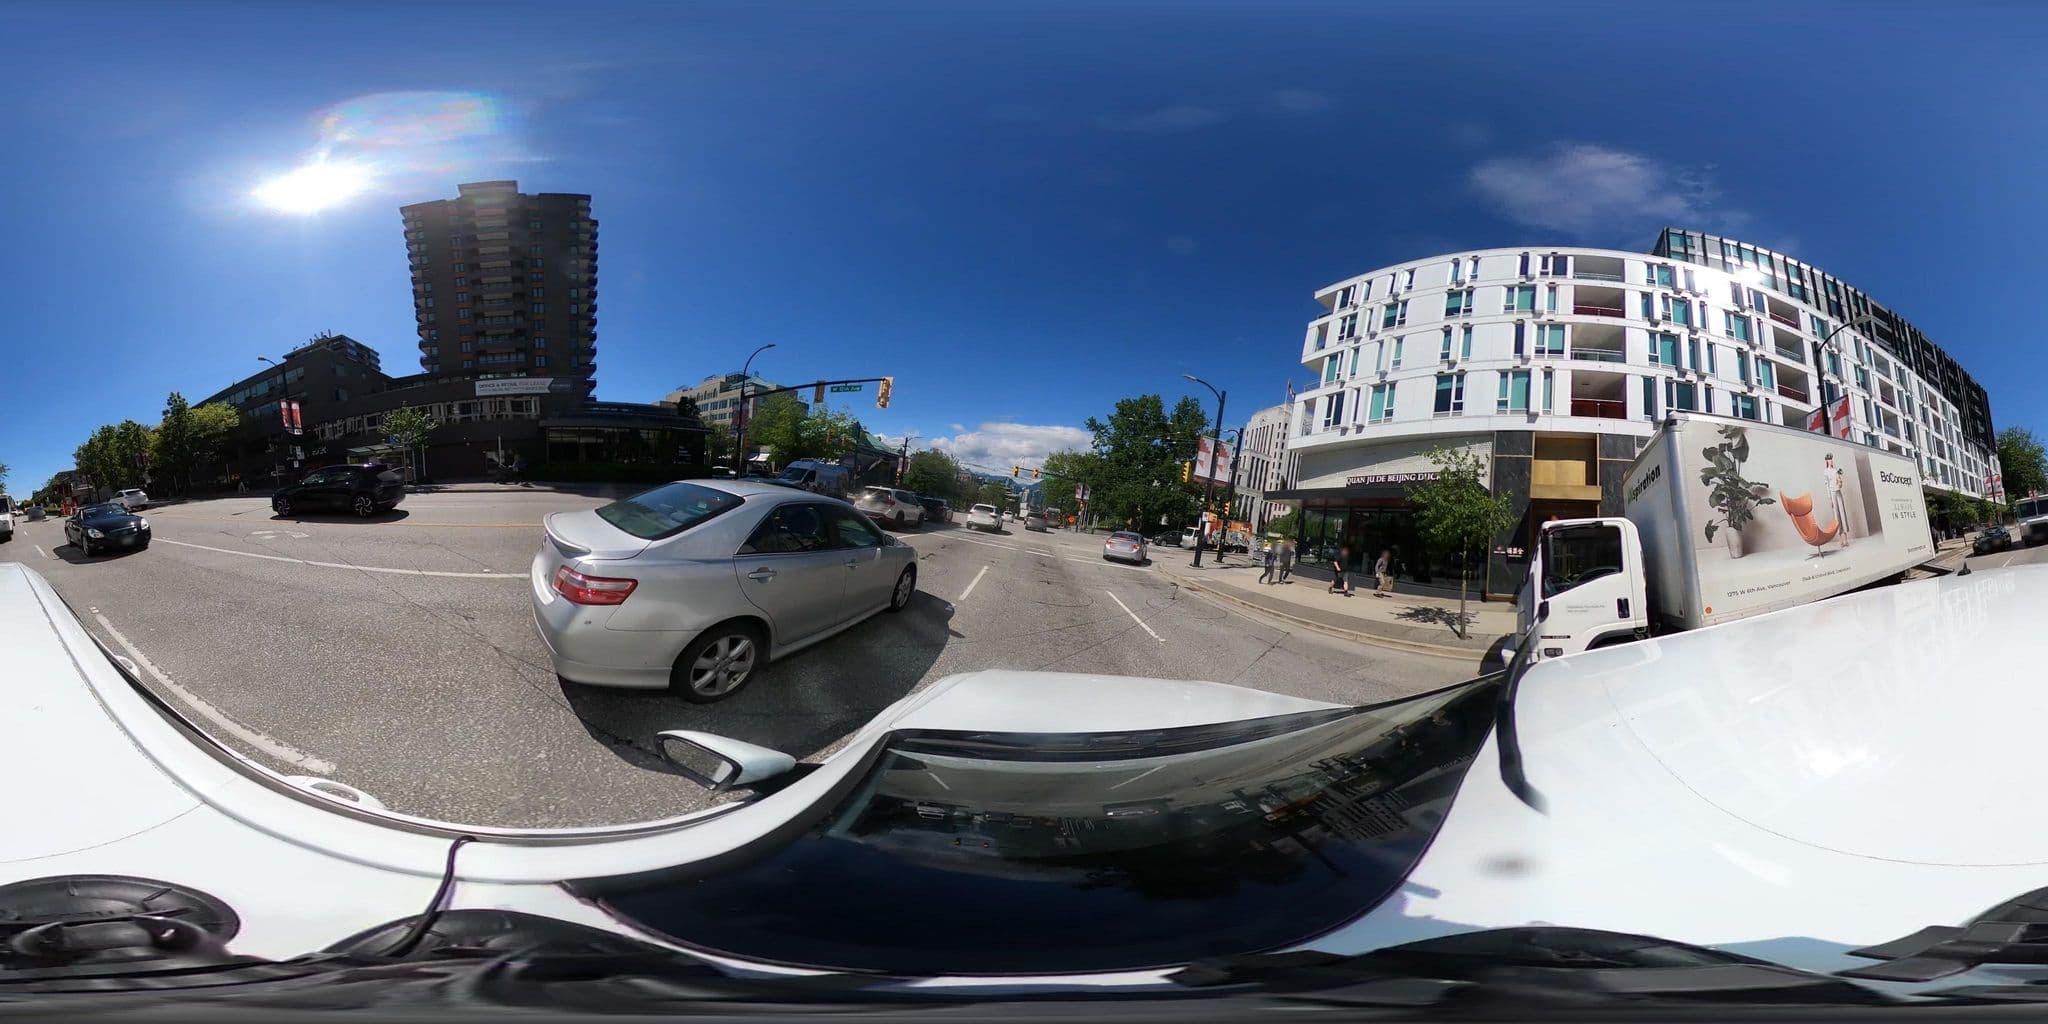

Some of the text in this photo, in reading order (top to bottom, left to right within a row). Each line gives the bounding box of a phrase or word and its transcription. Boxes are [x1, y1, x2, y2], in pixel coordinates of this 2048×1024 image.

[1346, 477, 1366, 486] QUAN
[1388, 474, 1416, 483] BEIJING
[1880, 471, 1912, 487] BoConcept
[1900, 511, 1917, 519] STYLE
